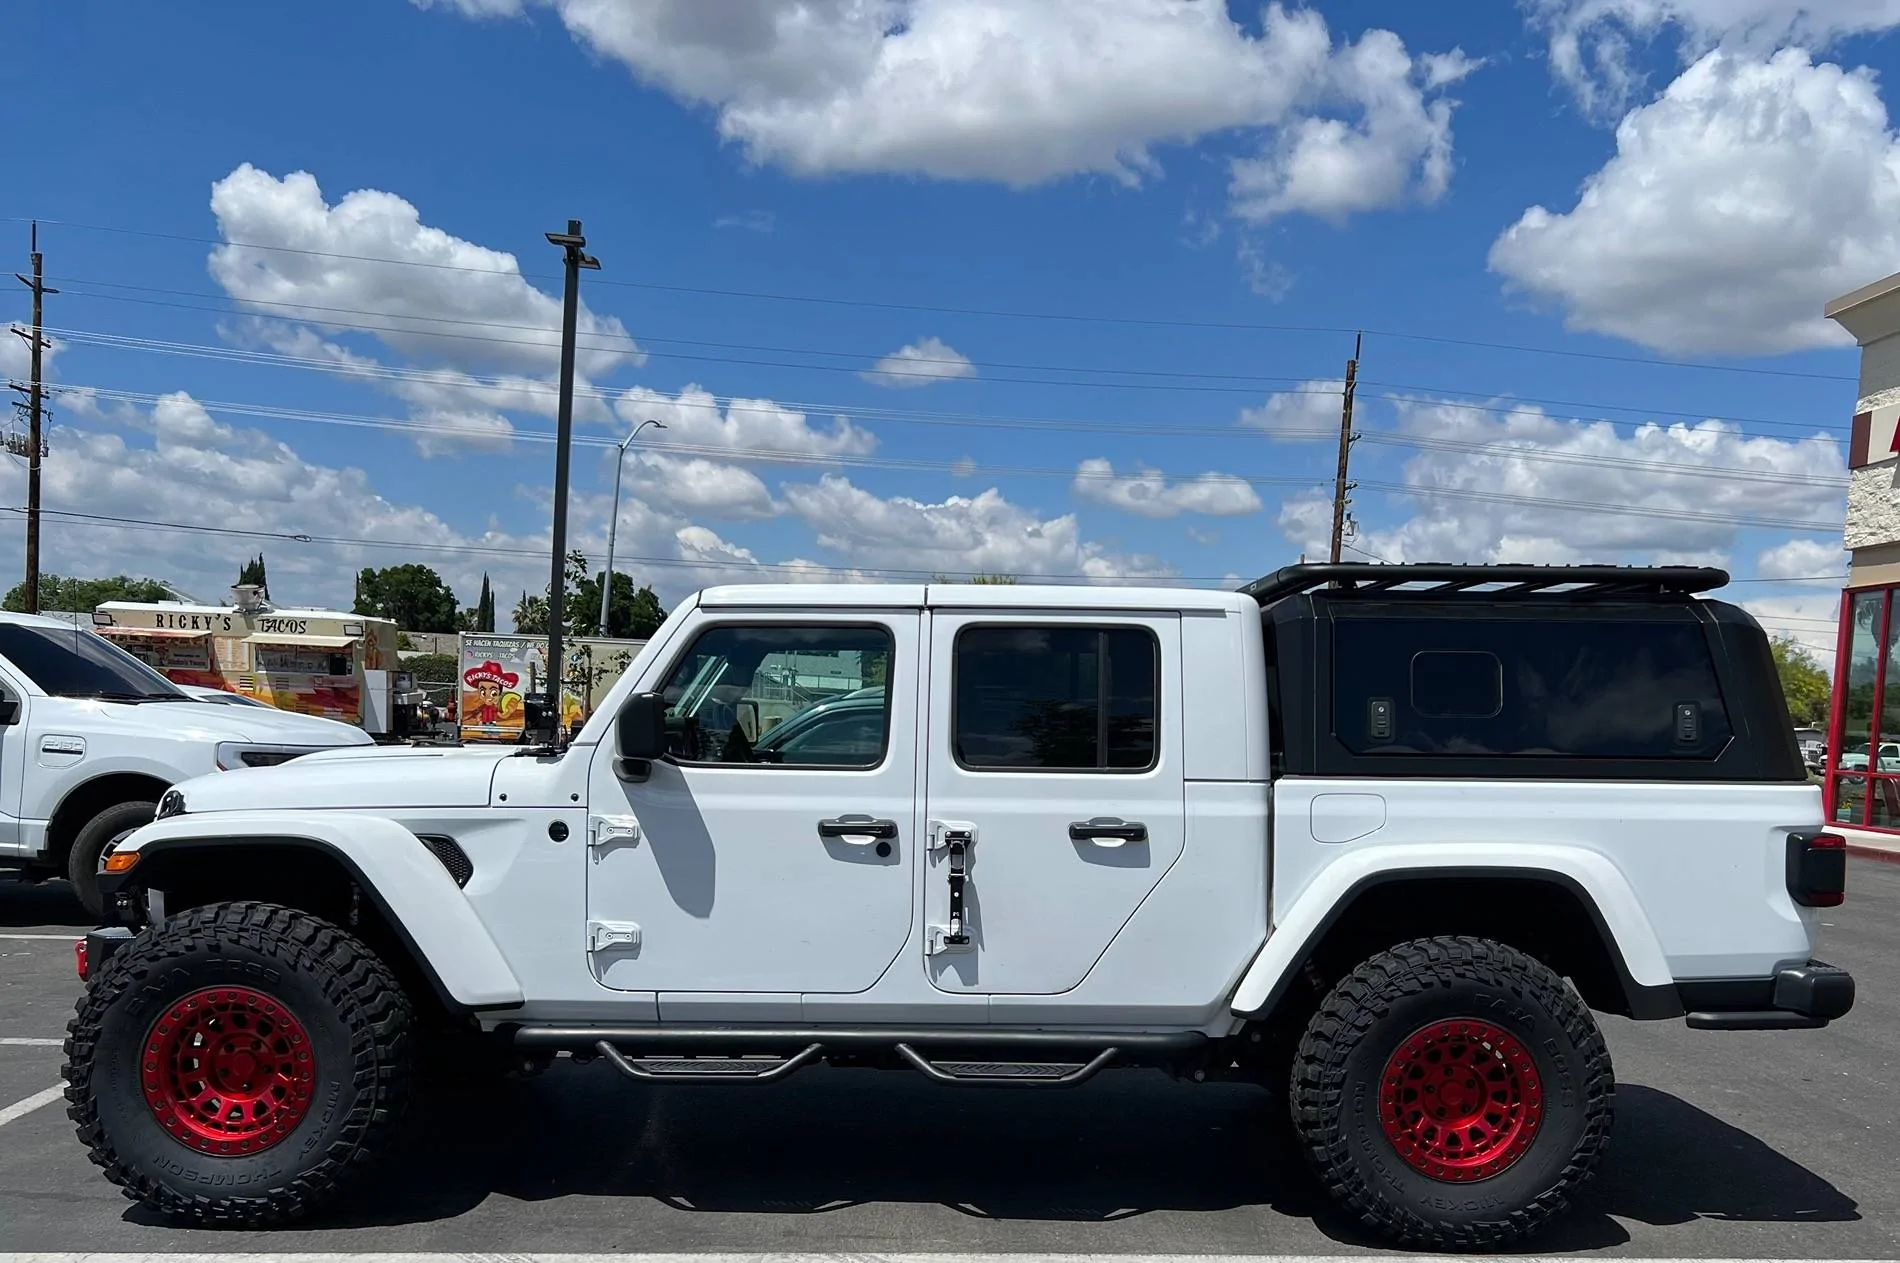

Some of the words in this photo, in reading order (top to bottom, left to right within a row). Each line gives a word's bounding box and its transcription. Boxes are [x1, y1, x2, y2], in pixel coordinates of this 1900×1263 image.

[156, 613, 231, 631] RICKY'S
[258, 618, 307, 634] TACOS
[466, 672, 491, 683] RICKY'S
[492, 674, 514, 688] TACOS
[151, 1152, 283, 1187] THOMPSON
